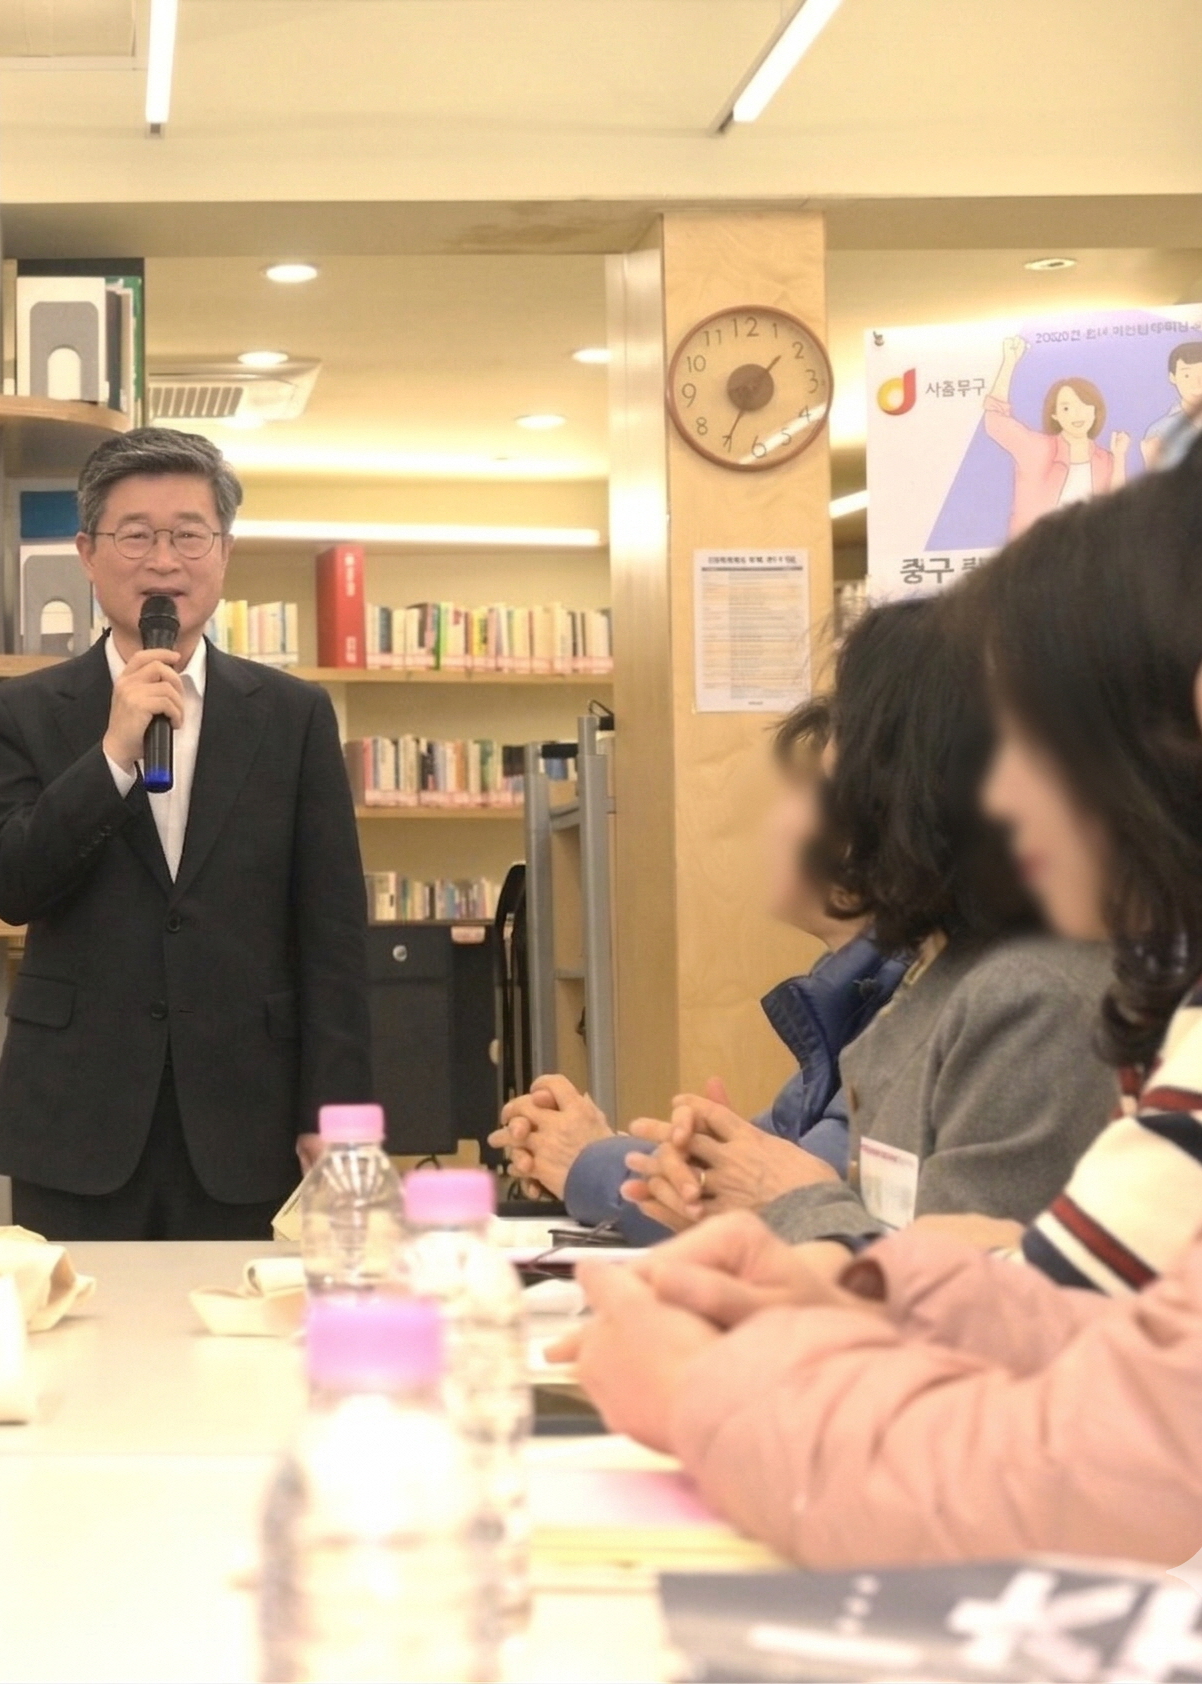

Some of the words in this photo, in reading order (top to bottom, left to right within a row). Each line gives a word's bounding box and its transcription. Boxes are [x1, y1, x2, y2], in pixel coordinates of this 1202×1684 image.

[732, 316, 760, 339] 12
[772, 322, 779, 340] 1
[703, 329, 723, 347] 11
[792, 341, 805, 360] 2
[686, 354, 708, 373] 10
[805, 369, 820, 395] 3
[681, 382, 697, 408] 9
[798, 405, 812, 423] 4
[695, 416, 709, 436] 8
[751, 434, 768, 459] 6
[780, 427, 793, 447] 5
